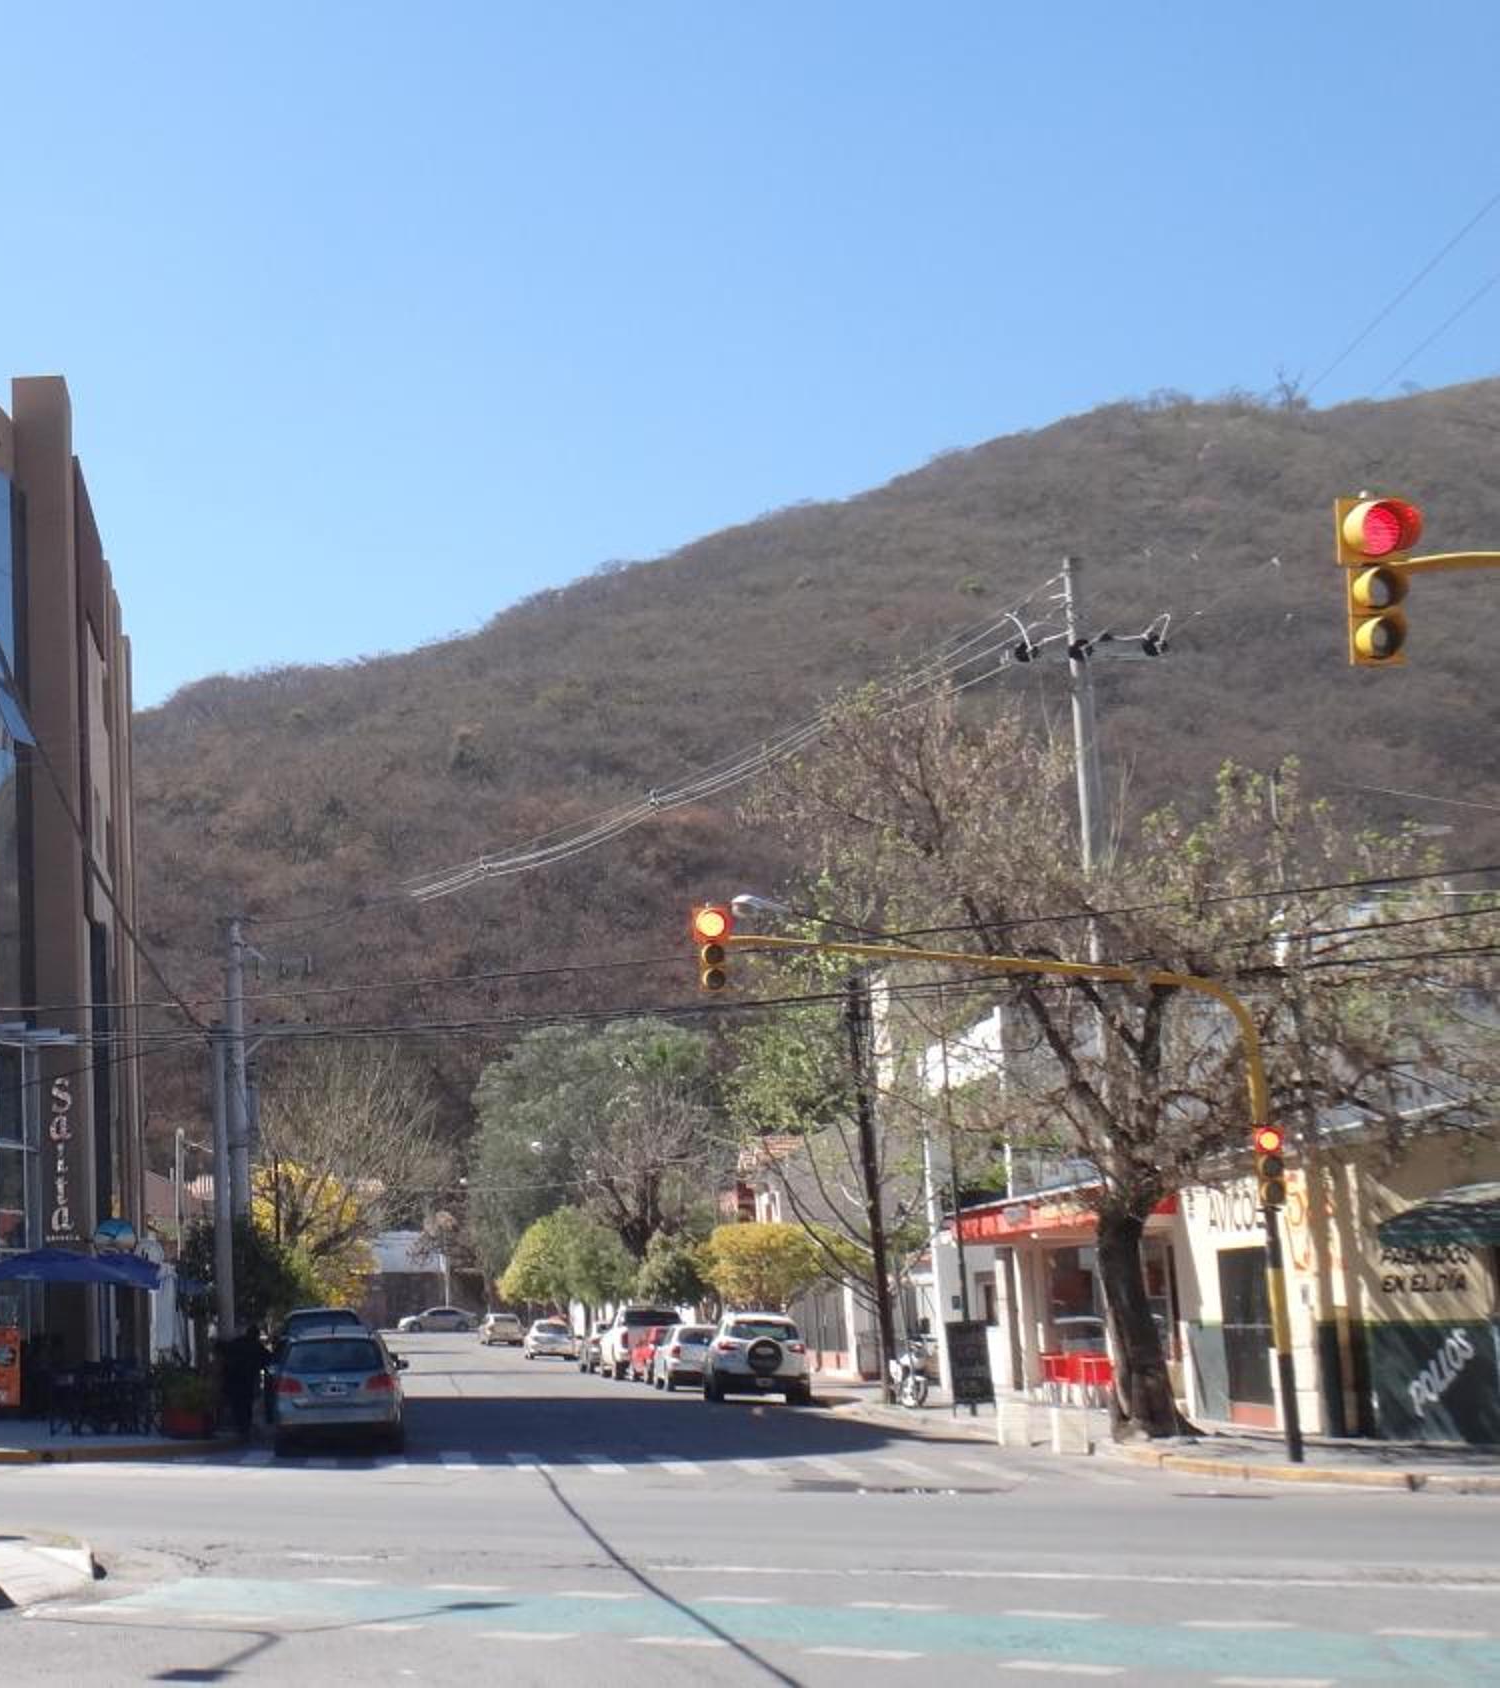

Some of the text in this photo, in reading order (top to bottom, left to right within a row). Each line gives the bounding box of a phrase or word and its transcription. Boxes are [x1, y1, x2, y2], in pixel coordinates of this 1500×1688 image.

[1382, 1275, 1405, 1293] EN
[1411, 1274, 1430, 1293] EL
[1409, 1328, 1475, 1418] POLLOS
